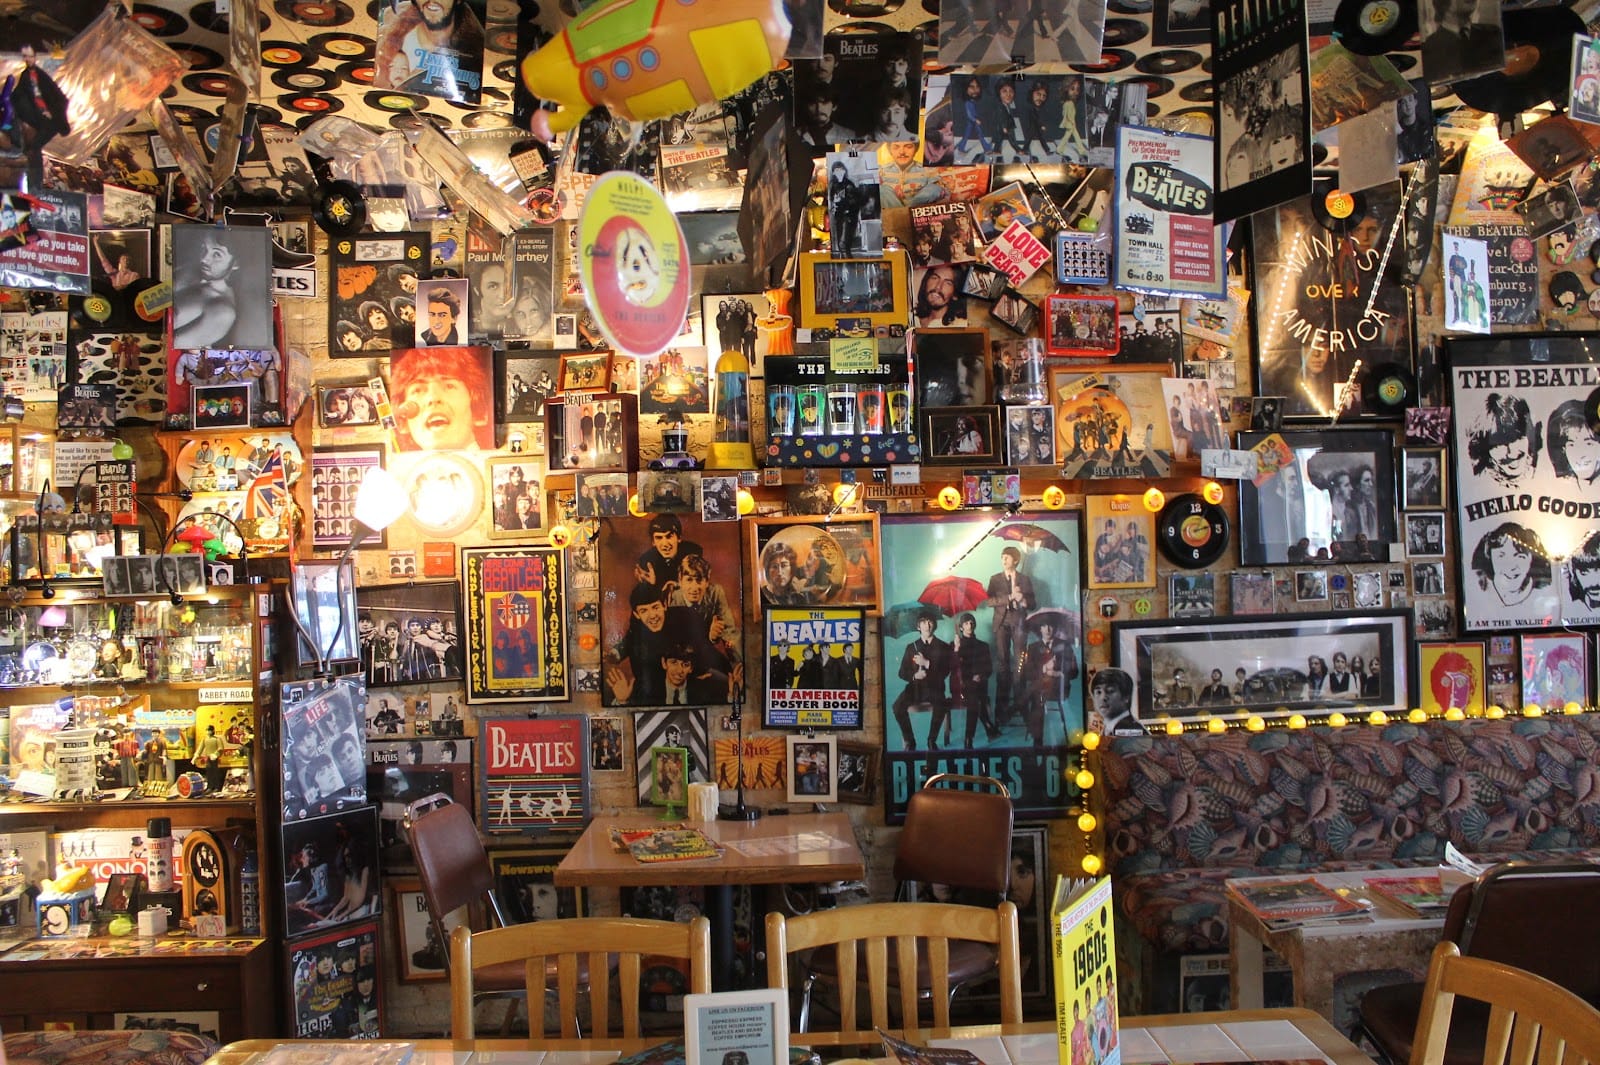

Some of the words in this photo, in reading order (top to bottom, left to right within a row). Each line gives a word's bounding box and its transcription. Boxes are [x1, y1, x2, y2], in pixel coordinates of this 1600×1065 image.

[840, 40, 879, 57] BEATLES
[667, 156, 684, 166] THE
[685, 148, 720, 161] BEATLES
[1152, 166, 1173, 178] THE
[1132, 166, 1207, 210] BEATLES
[915, 202, 966, 218] BEATLES
[1447, 226, 1471, 237] THE
[50, 240, 66, 251] you
[67, 241, 86, 253] take
[1003, 222, 1050, 269] LOVE
[1128, 239, 1147, 247] TOWN
[1148, 240, 1164, 249] HALL
[18, 247, 37, 260] love
[38, 252, 54, 264] you
[55, 254, 80, 267] make.
[468, 252, 490, 262] Paul
[492, 252, 550, 264] Mcartney
[985, 245, 1026, 286] PEACE
[1488, 263, 1538, 274] tar-Club
[1488, 279, 1533, 292] mburg,
[1489, 298, 1526, 310] many;
[1278, 308, 1390, 353] AMERICA
[797, 363, 825, 375] THE
[1459, 370, 1511, 389] THE
[1514, 366, 1600, 388] BEATL
[74, 385, 101, 399] BEATLES
[564, 389, 593, 407] BEATLES
[100, 463, 127, 474] BEATLES
[1093, 467, 1141, 476] BEATLES
[866, 486, 884, 497] THE
[884, 483, 927, 496] BEATLES
[1190, 503, 1202, 514] 12
[1465, 494, 1533, 522] HELLO
[1168, 526, 1175, 537] 9
[1215, 523, 1223, 534] 3
[1192, 548, 1200, 559] 6
[485, 567, 542, 592] BEATLES
[468, 557, 481, 650] CANDLESTICK
[809, 612, 825, 620] THE
[1493, 619, 1512, 627] THE
[1513, 617, 1553, 626] WALRUS
[773, 620, 860, 643] BEATLES
[471, 652, 484, 693] PARK
[205, 691, 228, 699] ABBEY
[230, 690, 250, 698] ROAD
[771, 690, 786, 700] IN
[791, 690, 858, 700] AMERICA
[771, 700, 820, 709] POSTER
[823, 701, 858, 709] BOOK
[305, 700, 329, 724] LIFE
[490, 726, 576, 774] BEATLES
[732, 742, 770, 758] BATLES
[374, 751, 398, 764] BEATLES
[47, 905, 69, 935] 9
[1084, 918, 1094, 937] THE
[1073, 929, 1108, 991] 1960s
[1060, 1015, 1068, 1045] HEALEY
